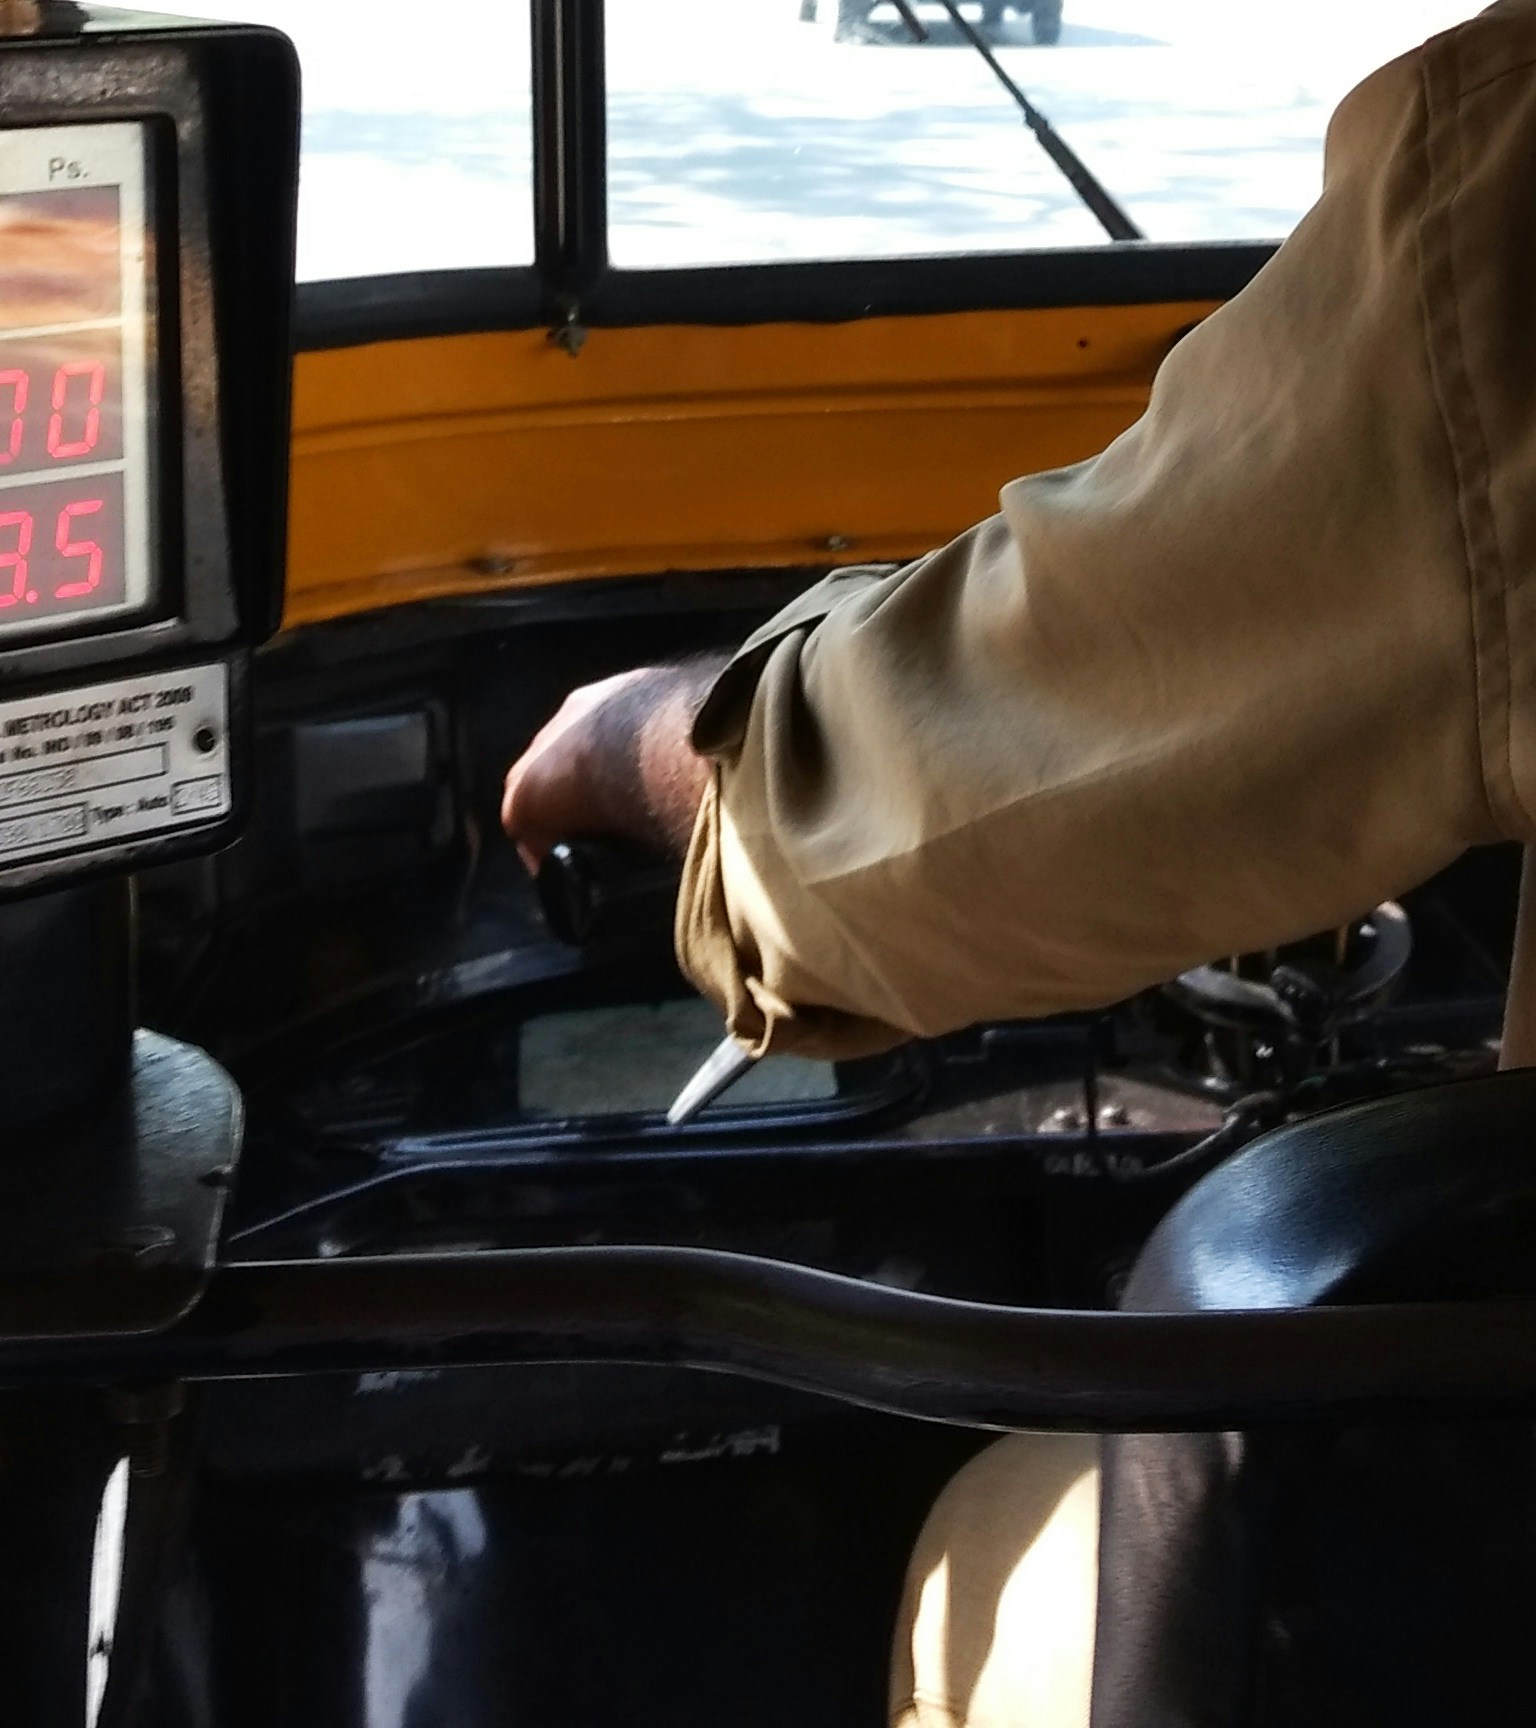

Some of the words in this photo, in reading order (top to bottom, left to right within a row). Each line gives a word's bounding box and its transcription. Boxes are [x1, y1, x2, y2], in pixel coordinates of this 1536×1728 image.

[48, 156, 90, 181] Ps.
[3, 699, 115, 739] METROLOGY
[117, 692, 152, 716] ACT
